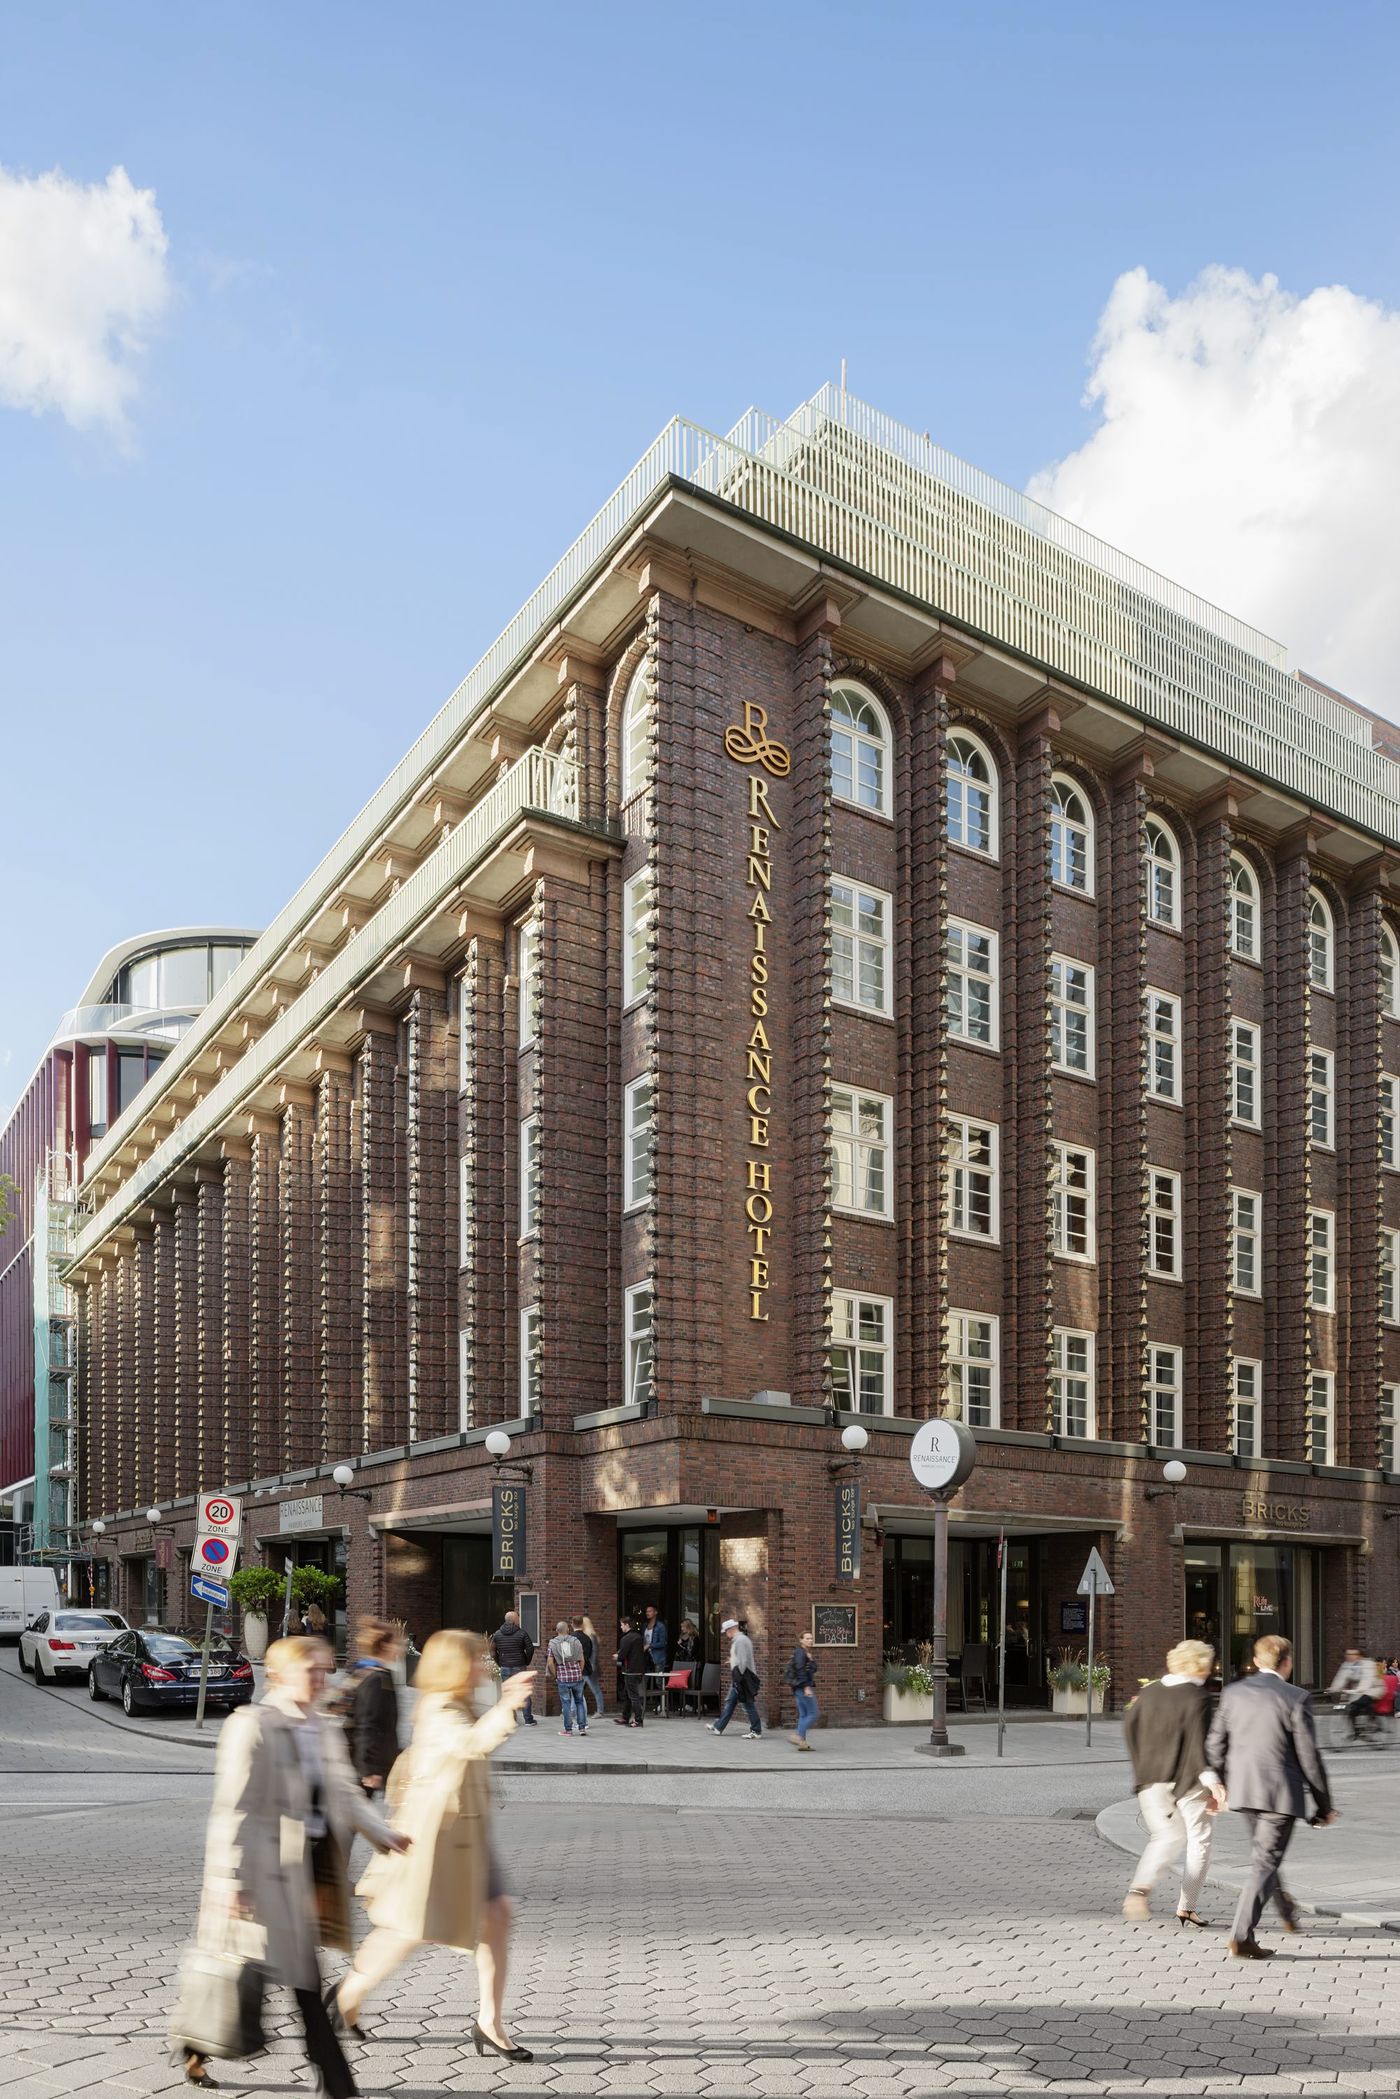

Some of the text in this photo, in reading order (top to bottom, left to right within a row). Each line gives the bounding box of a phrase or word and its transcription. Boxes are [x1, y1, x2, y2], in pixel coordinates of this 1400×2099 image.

[745, 775, 782, 1321] RENAISSANCE HOTEL
[930, 1436, 940, 1452] R
[912, 1454, 957, 1464] RENAISSANCE
[211, 1505, 228, 1518] 20
[280, 1497, 322, 1518] RENAISSANCE
[1242, 1500, 1309, 1521] BRICKS
[207, 1524, 229, 1534] ZONE
[500, 1490, 514, 1570] BRICKS
[841, 1488, 852, 1572] BRICKS
[201, 1563, 223, 1574] ZONE
